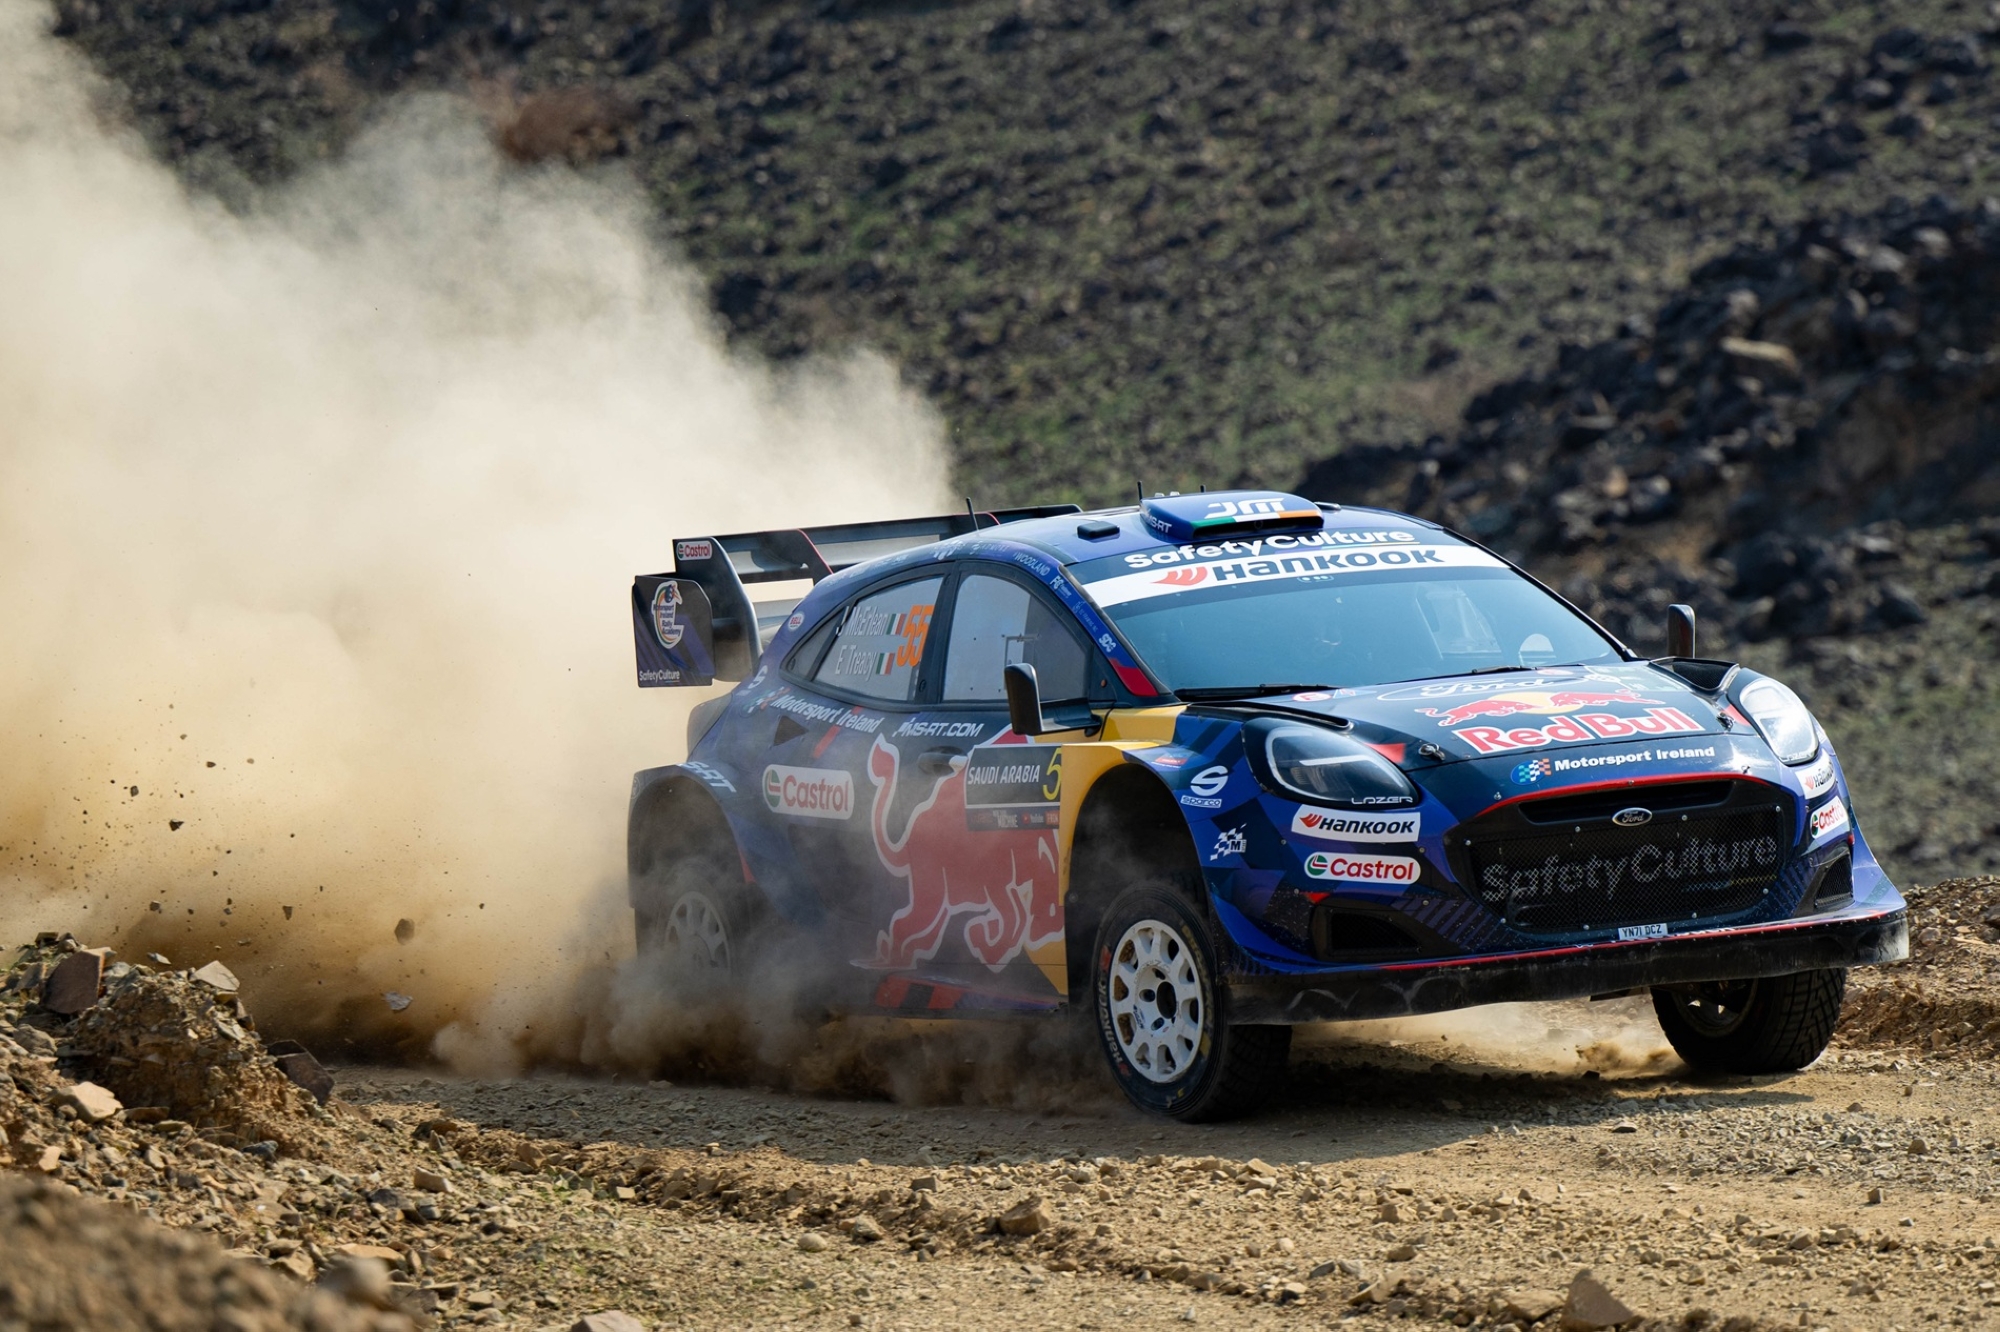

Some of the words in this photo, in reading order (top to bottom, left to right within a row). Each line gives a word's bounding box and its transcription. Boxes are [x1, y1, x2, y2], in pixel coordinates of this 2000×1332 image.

[685, 544, 711, 558] Castrol
[1124, 530, 1417, 569] SafetyCulture
[662, 620, 673, 629] Rally
[846, 606, 889, 636] McErlean
[662, 628, 681, 637] Academy
[896, 605, 935, 667] 55
[835, 644, 847, 674] E
[845, 645, 877, 682] Treacy
[639, 670, 680, 682] SafetyCulture
[1420, 678, 1554, 697] Ford
[770, 694, 838, 726] Motorsport
[837, 709, 884, 733] Ireland
[1453, 716, 1595, 754] Red
[1572, 707, 1706, 738] Bull
[1555, 752, 1651, 771] Motorsport
[1656, 747, 1715, 759] Ireland
[967, 766, 999, 785] SAUDI
[1000, 765, 1040, 783] ARABIA
[785, 776, 849, 812] Castrol
[1182, 797, 1220, 807] sparco
[1621, 811, 1645, 823] Ford
[1330, 858, 1414, 880] Castrol
[1482, 836, 1778, 901] SafetyCulture
[1622, 926, 1643, 938] YN71
[1644, 925, 1662, 936] DCZ
